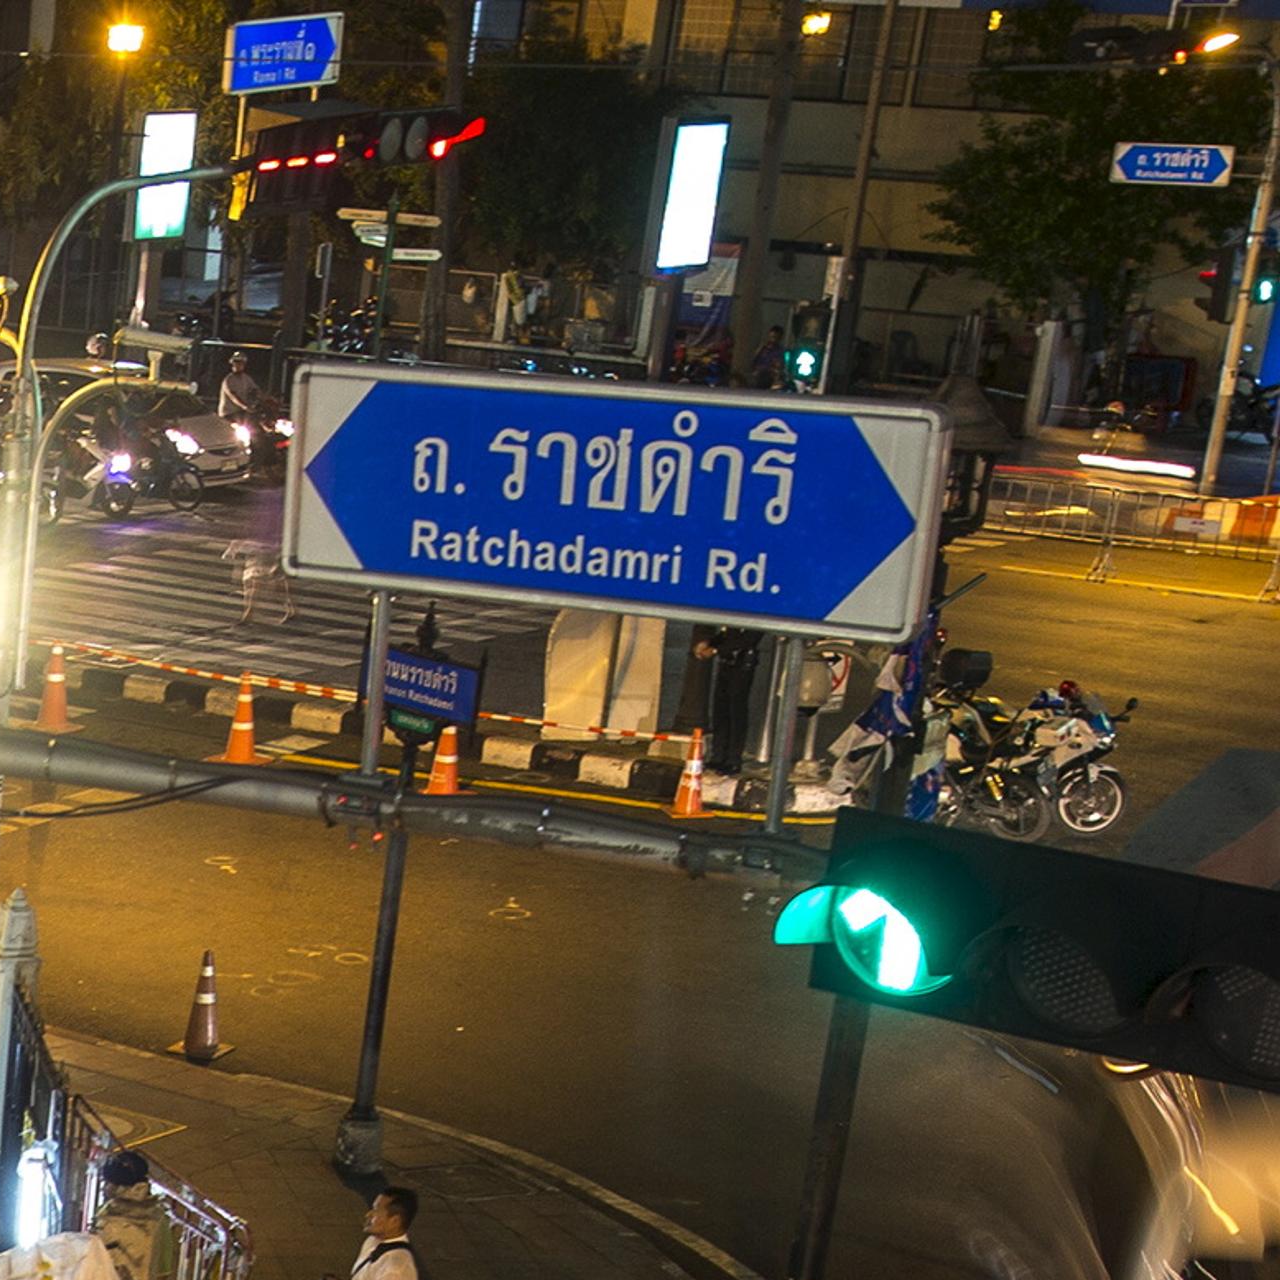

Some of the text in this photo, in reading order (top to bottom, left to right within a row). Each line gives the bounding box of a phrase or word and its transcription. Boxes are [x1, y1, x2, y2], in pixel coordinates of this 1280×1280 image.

[413, 410, 798, 525] ถ. ราชดำริ
[409, 519, 781, 594] Ratchadamri Rd.
